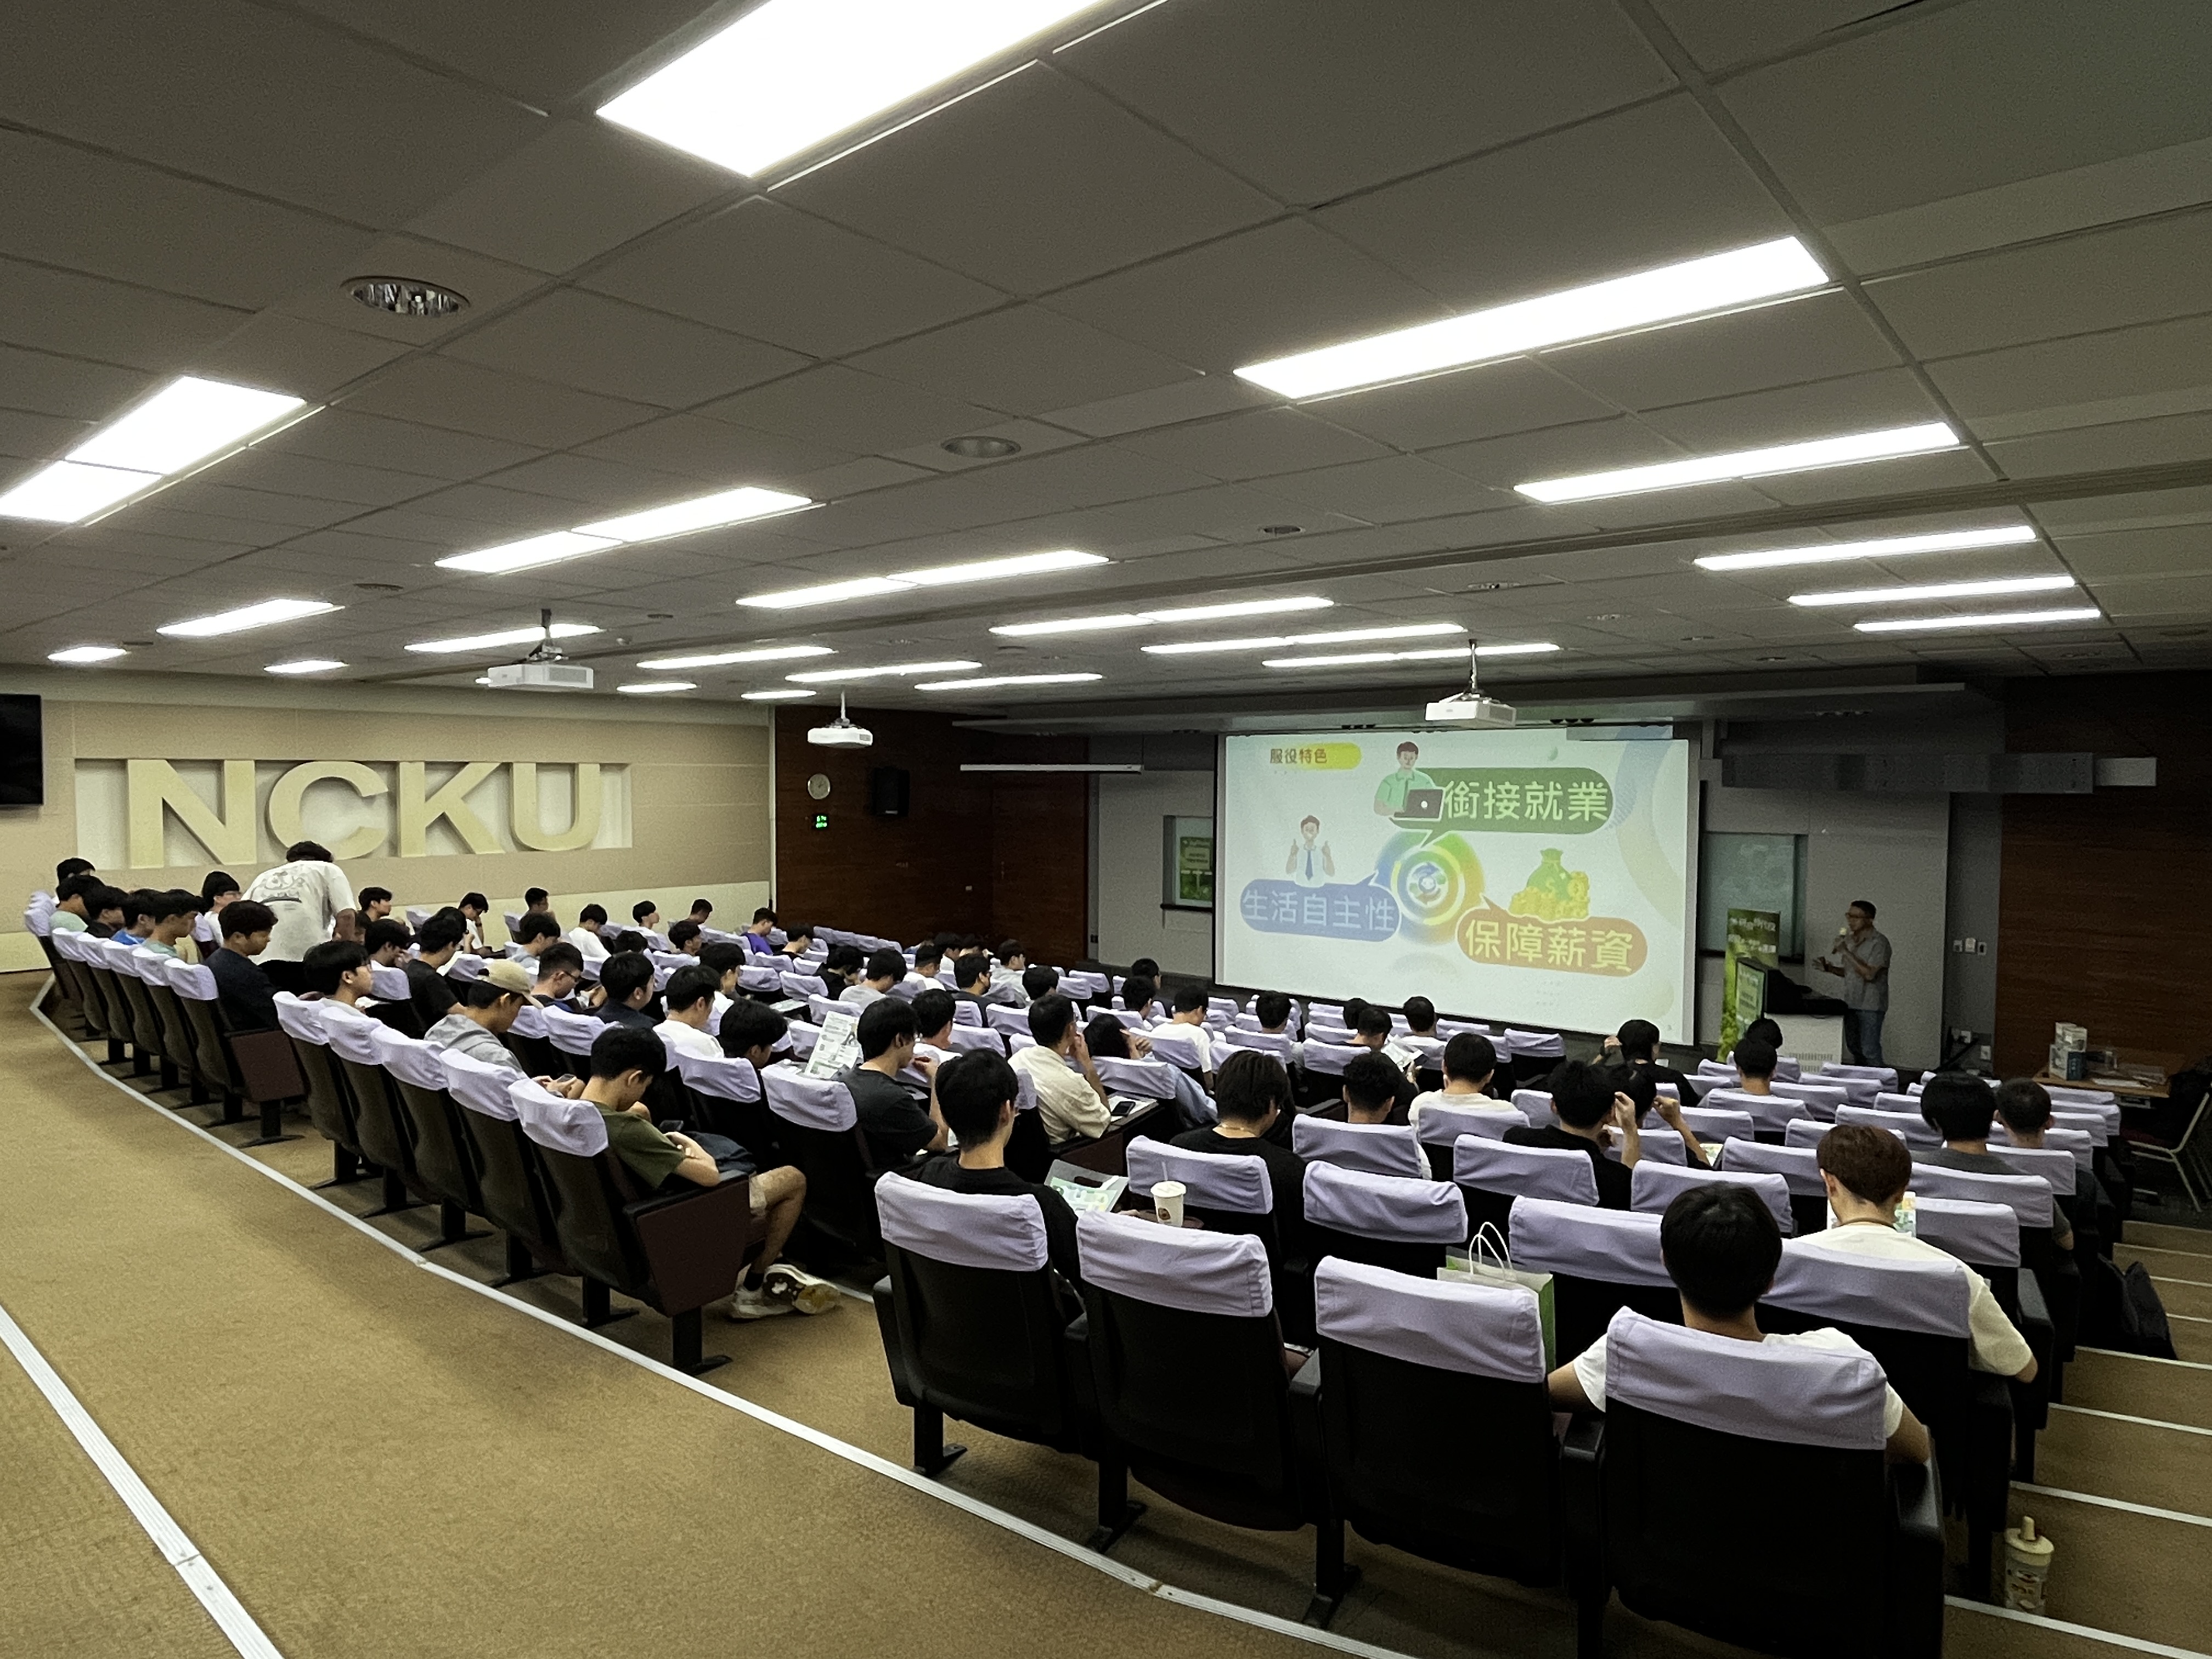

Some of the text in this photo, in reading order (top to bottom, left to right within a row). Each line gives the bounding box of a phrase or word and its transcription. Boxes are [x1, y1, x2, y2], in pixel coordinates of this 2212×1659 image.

[1269, 748, 1328, 764] 服役特色
[127, 759, 601, 869] NCKU
[1444, 775, 1609, 821] 銜接就業
[1242, 888, 1395, 932] 生活自主性
[1465, 919, 1633, 973] 保障薪資
